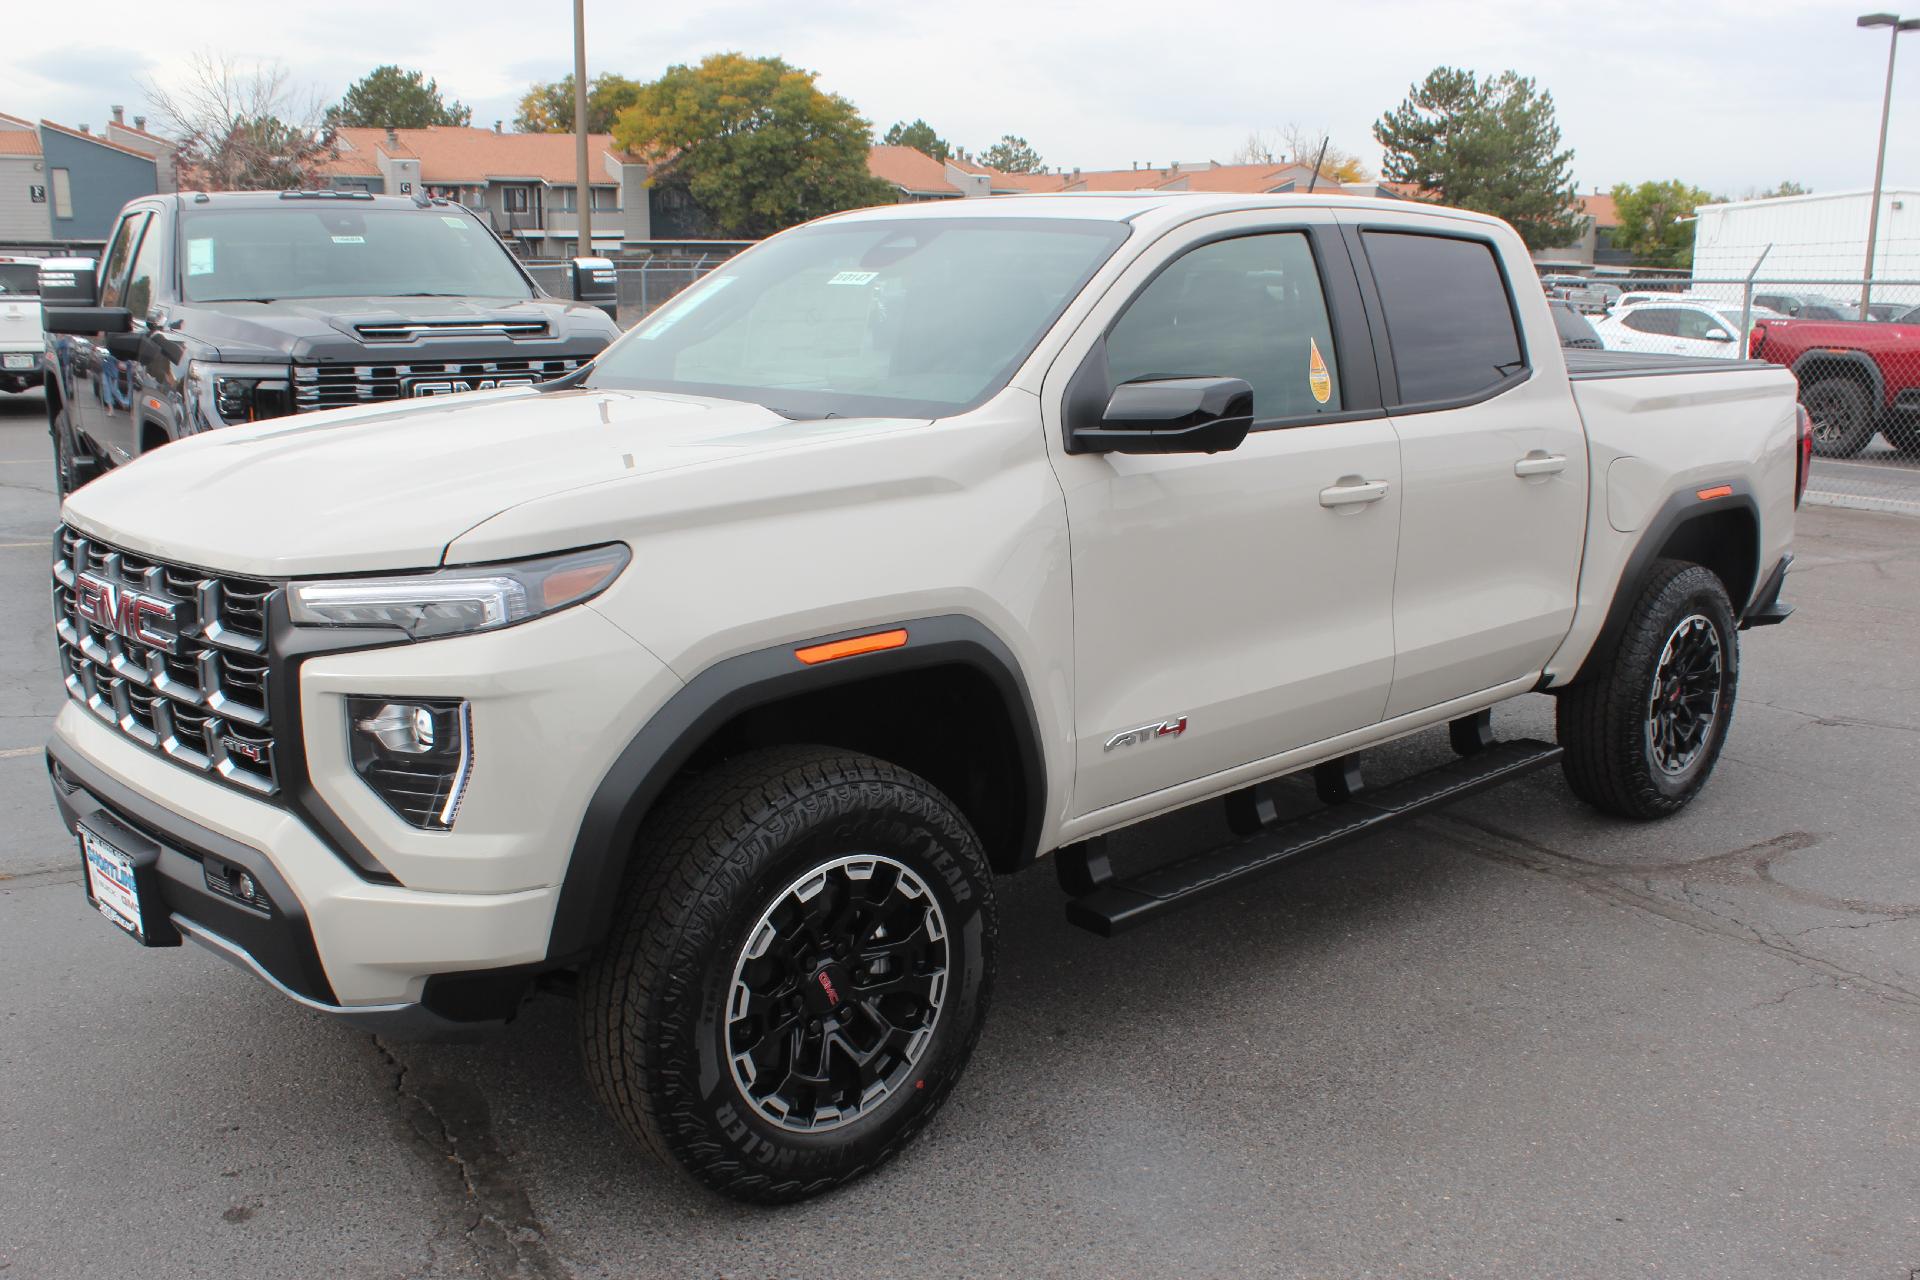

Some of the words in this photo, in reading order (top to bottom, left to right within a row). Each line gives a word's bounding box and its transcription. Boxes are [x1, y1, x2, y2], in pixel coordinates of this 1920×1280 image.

[76, 573, 177, 656] GMC
[1104, 716, 1188, 752] AT4
[818, 971, 840, 1006] GMC
